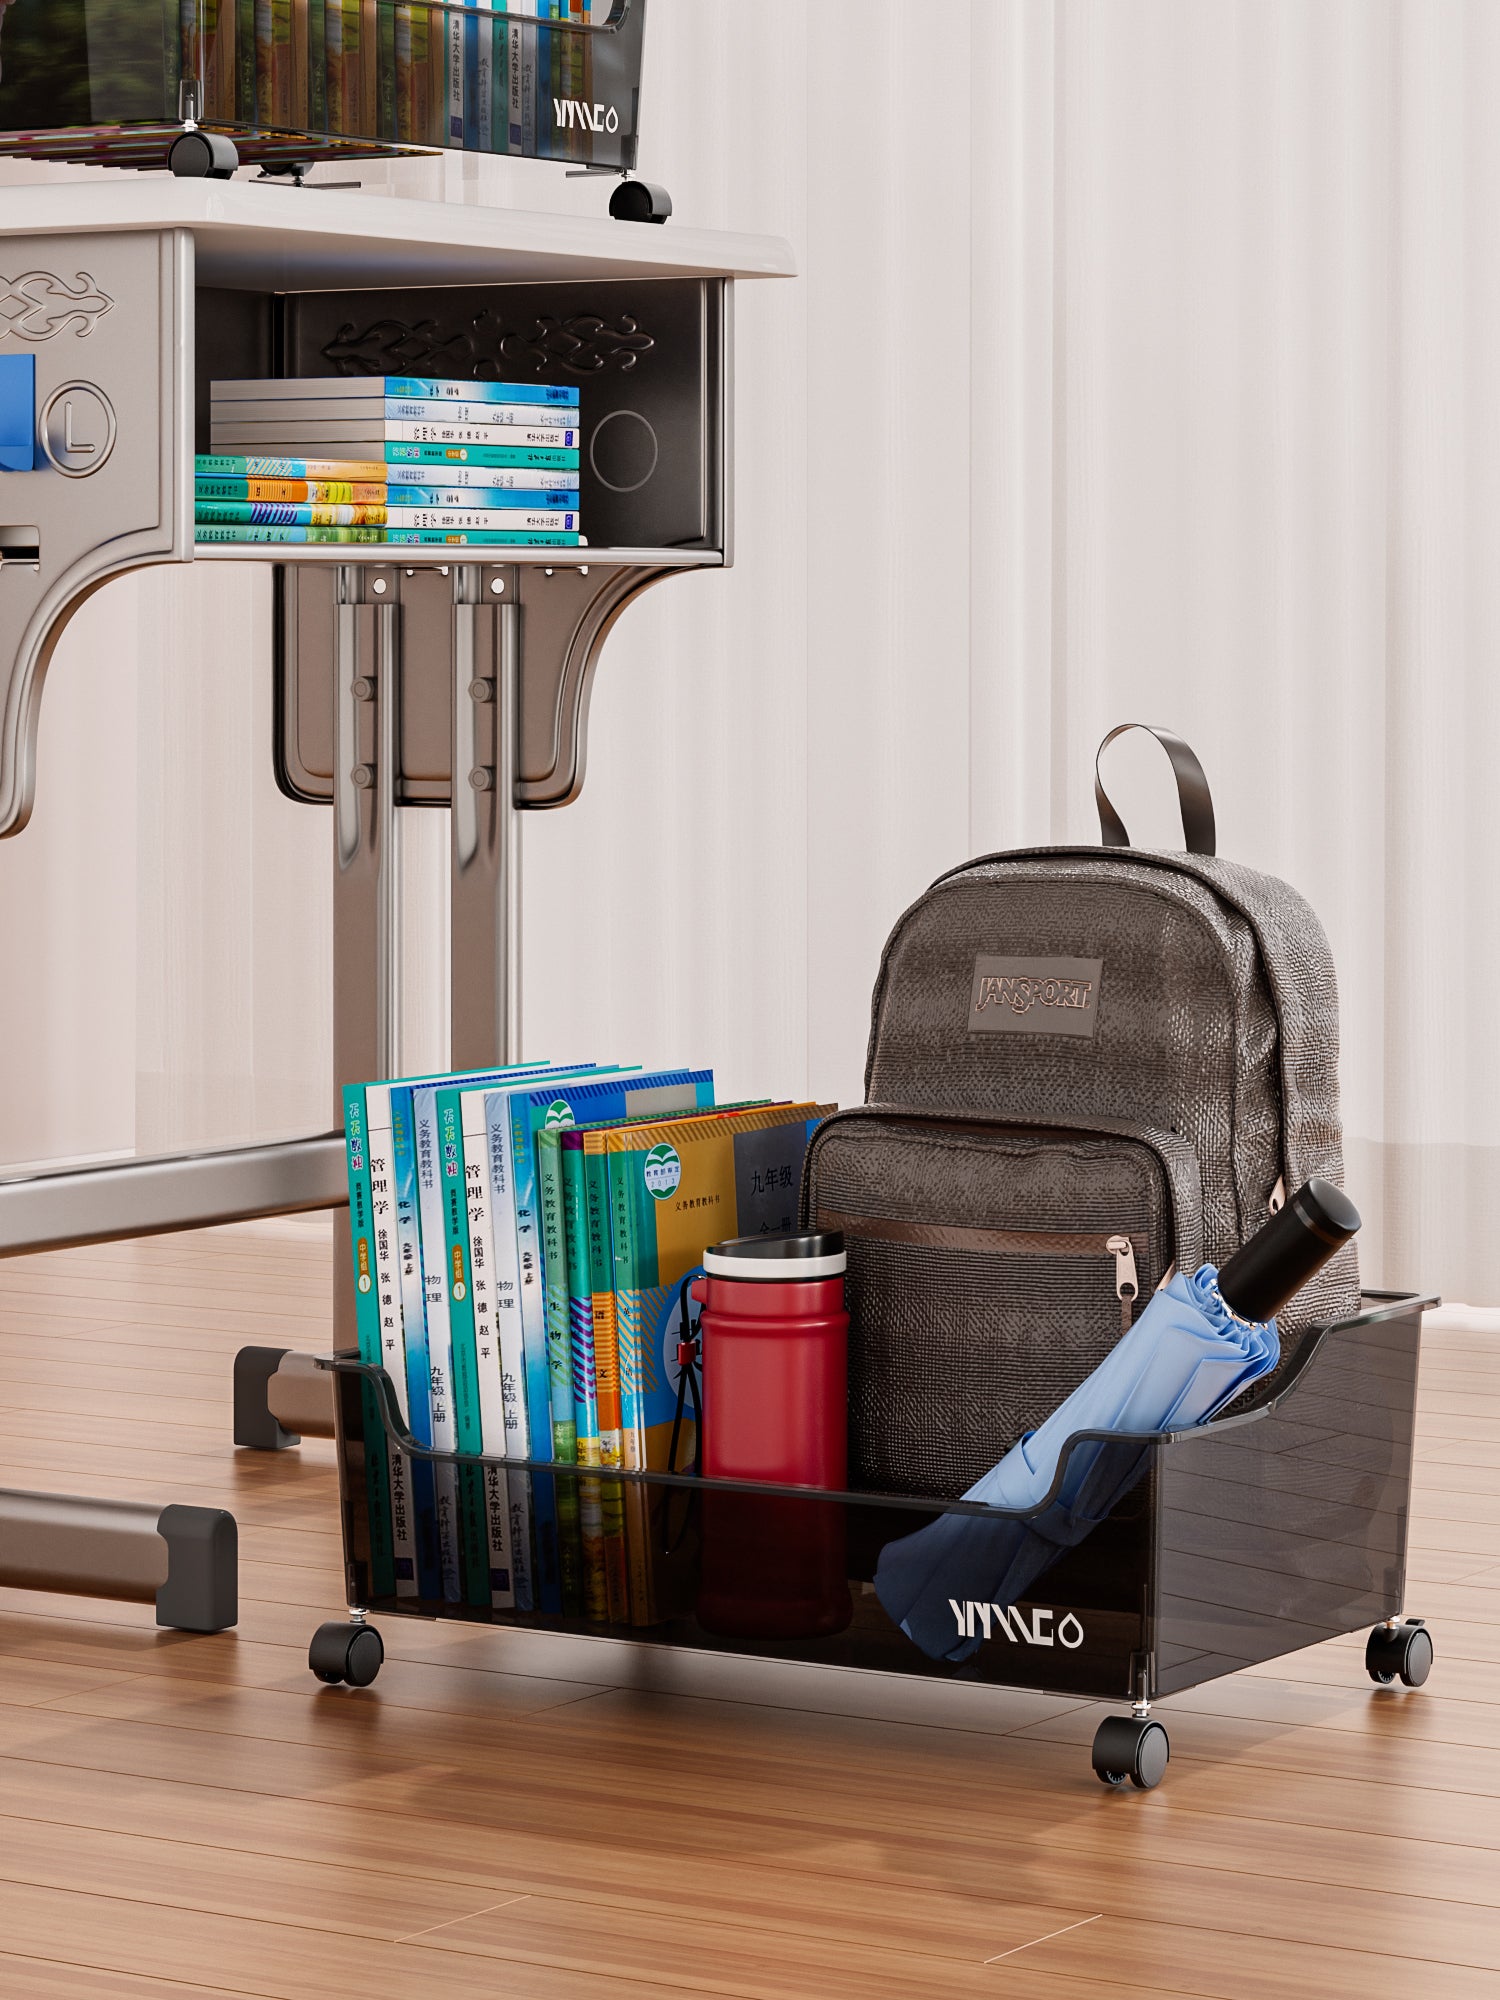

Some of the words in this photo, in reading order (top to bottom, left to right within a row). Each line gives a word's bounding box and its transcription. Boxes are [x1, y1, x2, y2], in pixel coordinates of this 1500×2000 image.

[63, 400, 96, 453] L
[975, 976, 1092, 1014] JANSPORT
[419, 1119, 434, 1189] 义务教育教科书
[491, 1123, 506, 1194] 义务教育教科书
[370, 1158, 389, 1215] 管理学
[465, 1164, 484, 1221] 管理学
[750, 1164, 794, 1197] 九年级
[543, 1173, 558, 1259] 义务教育教科书
[616, 1176, 629, 1265] 义务教育教科书
[675, 1194, 720, 1212] 义务教育教科书
[589, 1180, 603, 1268] 义务教育教科书
[377, 1229, 389, 1260] 徐国华
[473, 1236, 485, 1268] 徐国华
[424, 1274, 442, 1303] 物理
[497, 1280, 514, 1309] 物理
[549, 1301, 563, 1370] 生物学
[430, 1366, 445, 1396] 九年级
[502, 1372, 517, 1403] 九年级
[432, 1402, 446, 1423] 上册
[504, 1408, 518, 1429] 上册
[391, 1453, 408, 1541] 清华大学出版社
